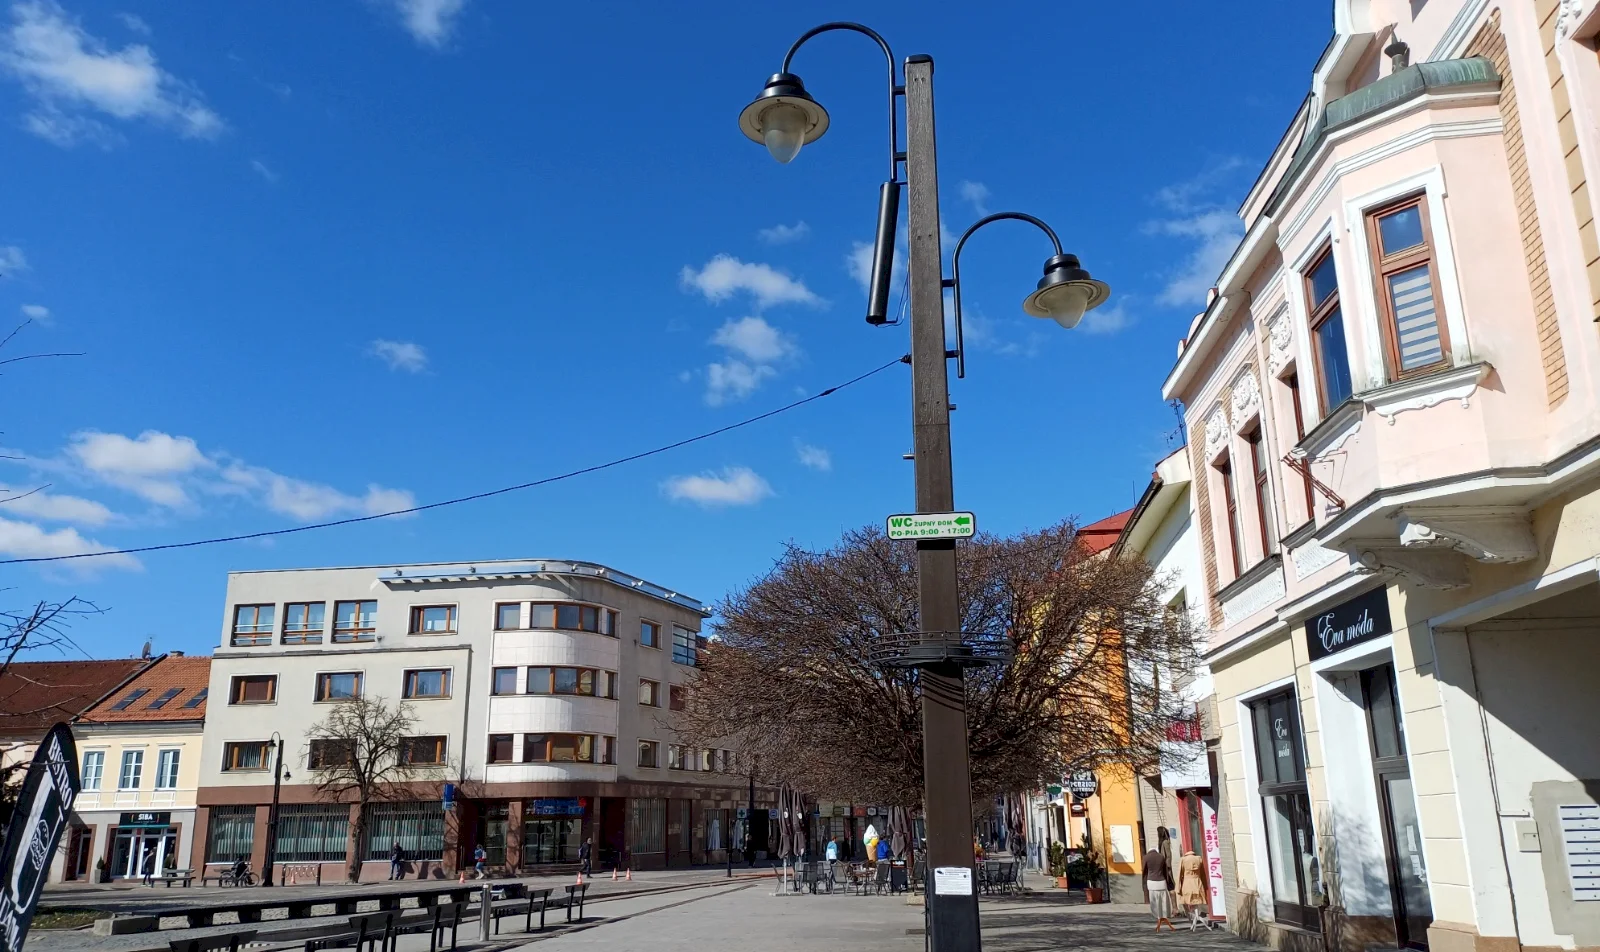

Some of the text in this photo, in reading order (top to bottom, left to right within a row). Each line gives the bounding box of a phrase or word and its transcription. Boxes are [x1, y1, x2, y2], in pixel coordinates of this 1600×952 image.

[890, 517, 912, 527] WC
[1317, 608, 1374, 652] Eva móda
[1274, 717, 1288, 740] Eva
[47, 732, 73, 811] BISTRO
[137, 813, 153, 821] SIBA
[1206, 829, 1214, 853] HAND
[1209, 856, 1223, 879] No.1
